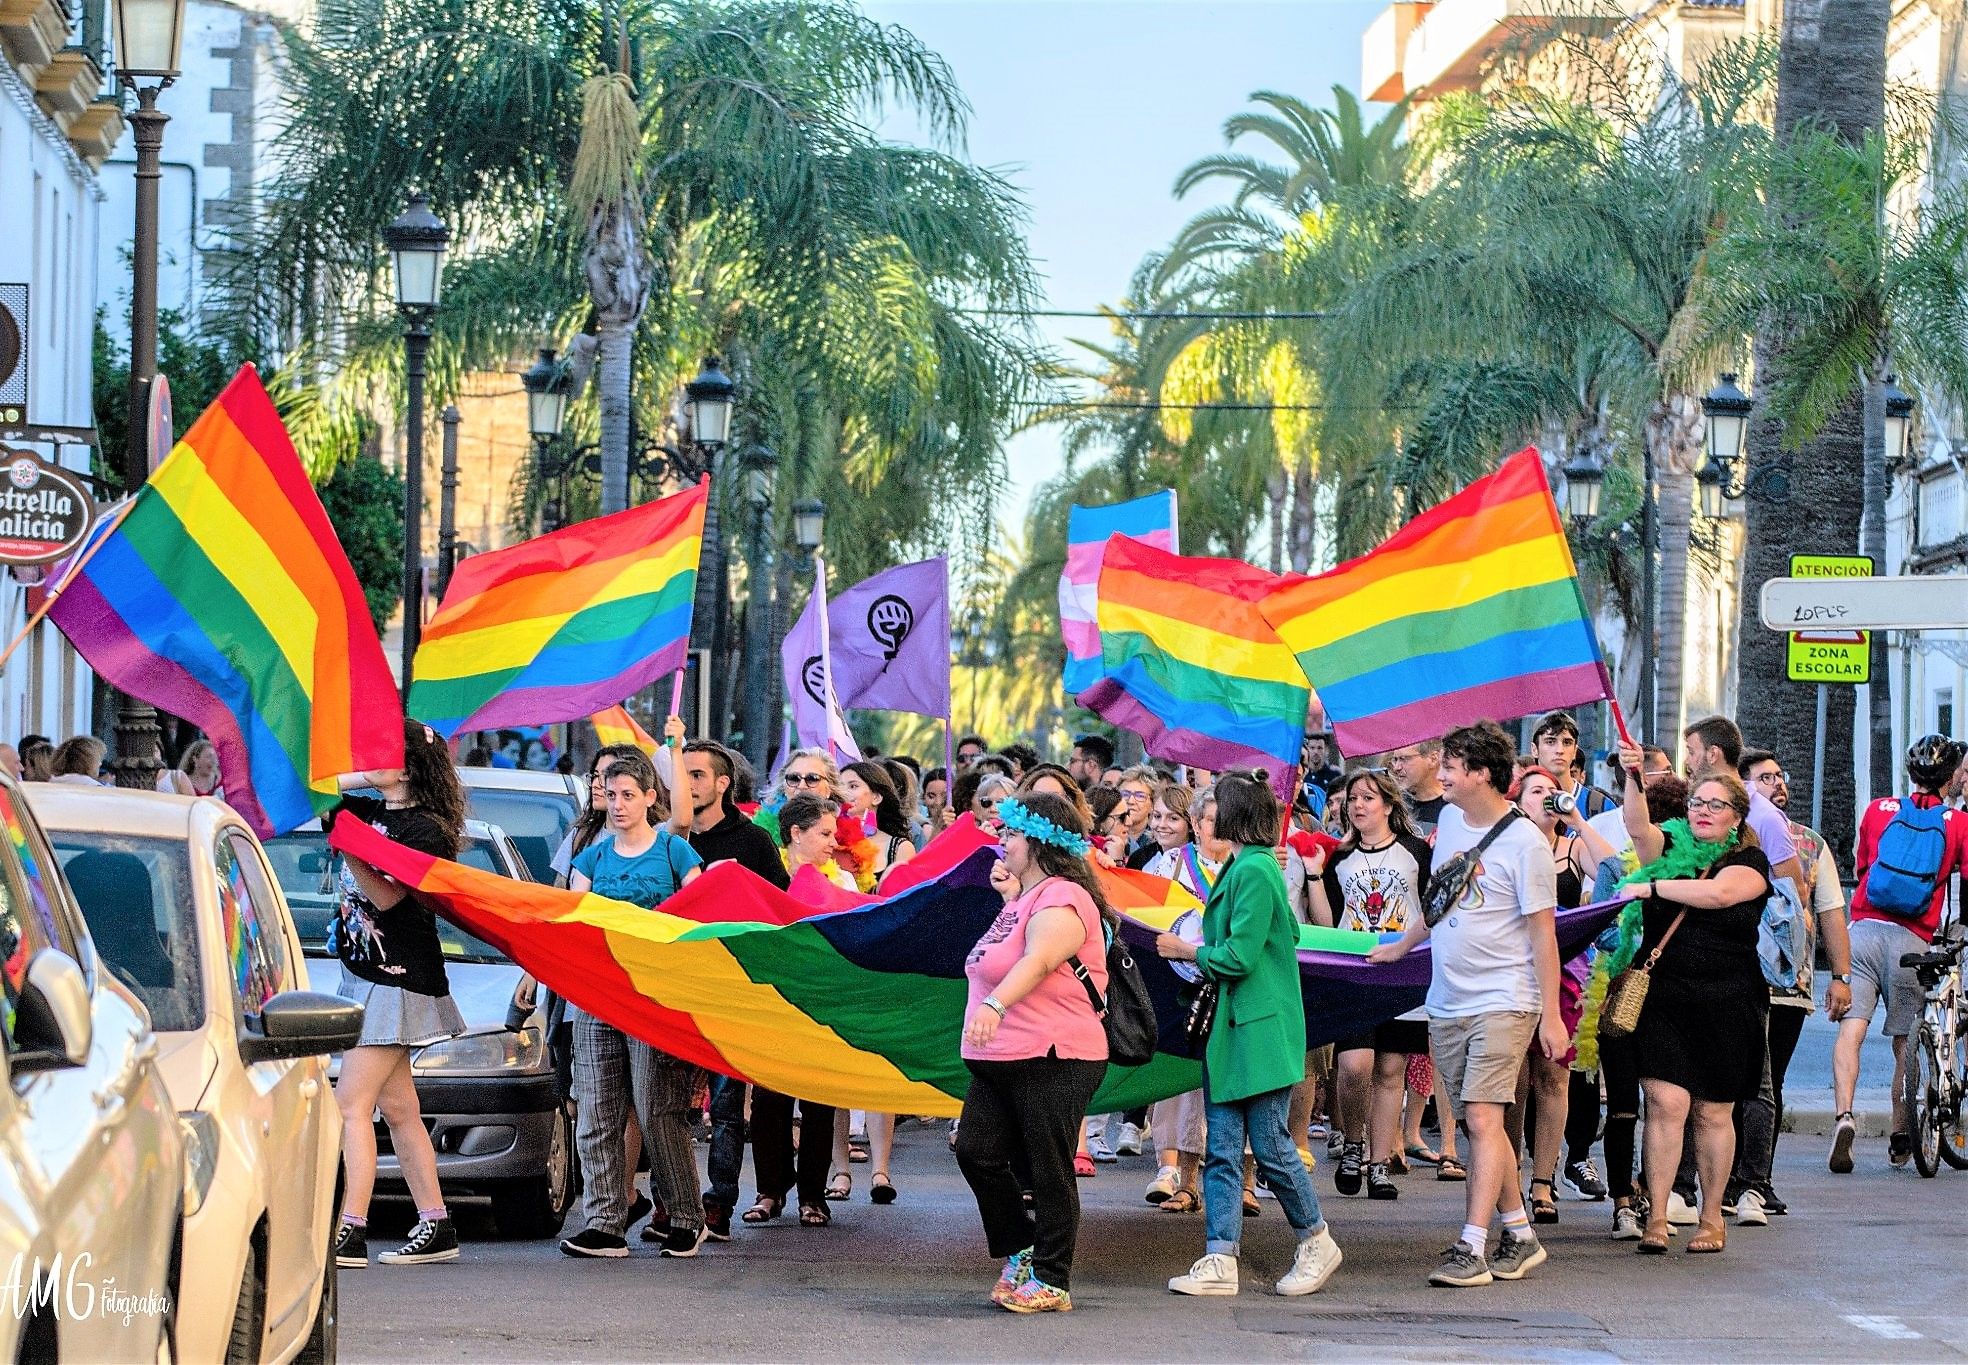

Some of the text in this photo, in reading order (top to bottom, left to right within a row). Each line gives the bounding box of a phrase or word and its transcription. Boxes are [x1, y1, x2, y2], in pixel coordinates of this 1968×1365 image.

[0, 513, 65, 540] alicia
[1809, 647, 1849, 659] ZONA
[1795, 662, 1862, 675] ESCOLAR
[1345, 867, 1409, 895] HELLFIRE CLUB
